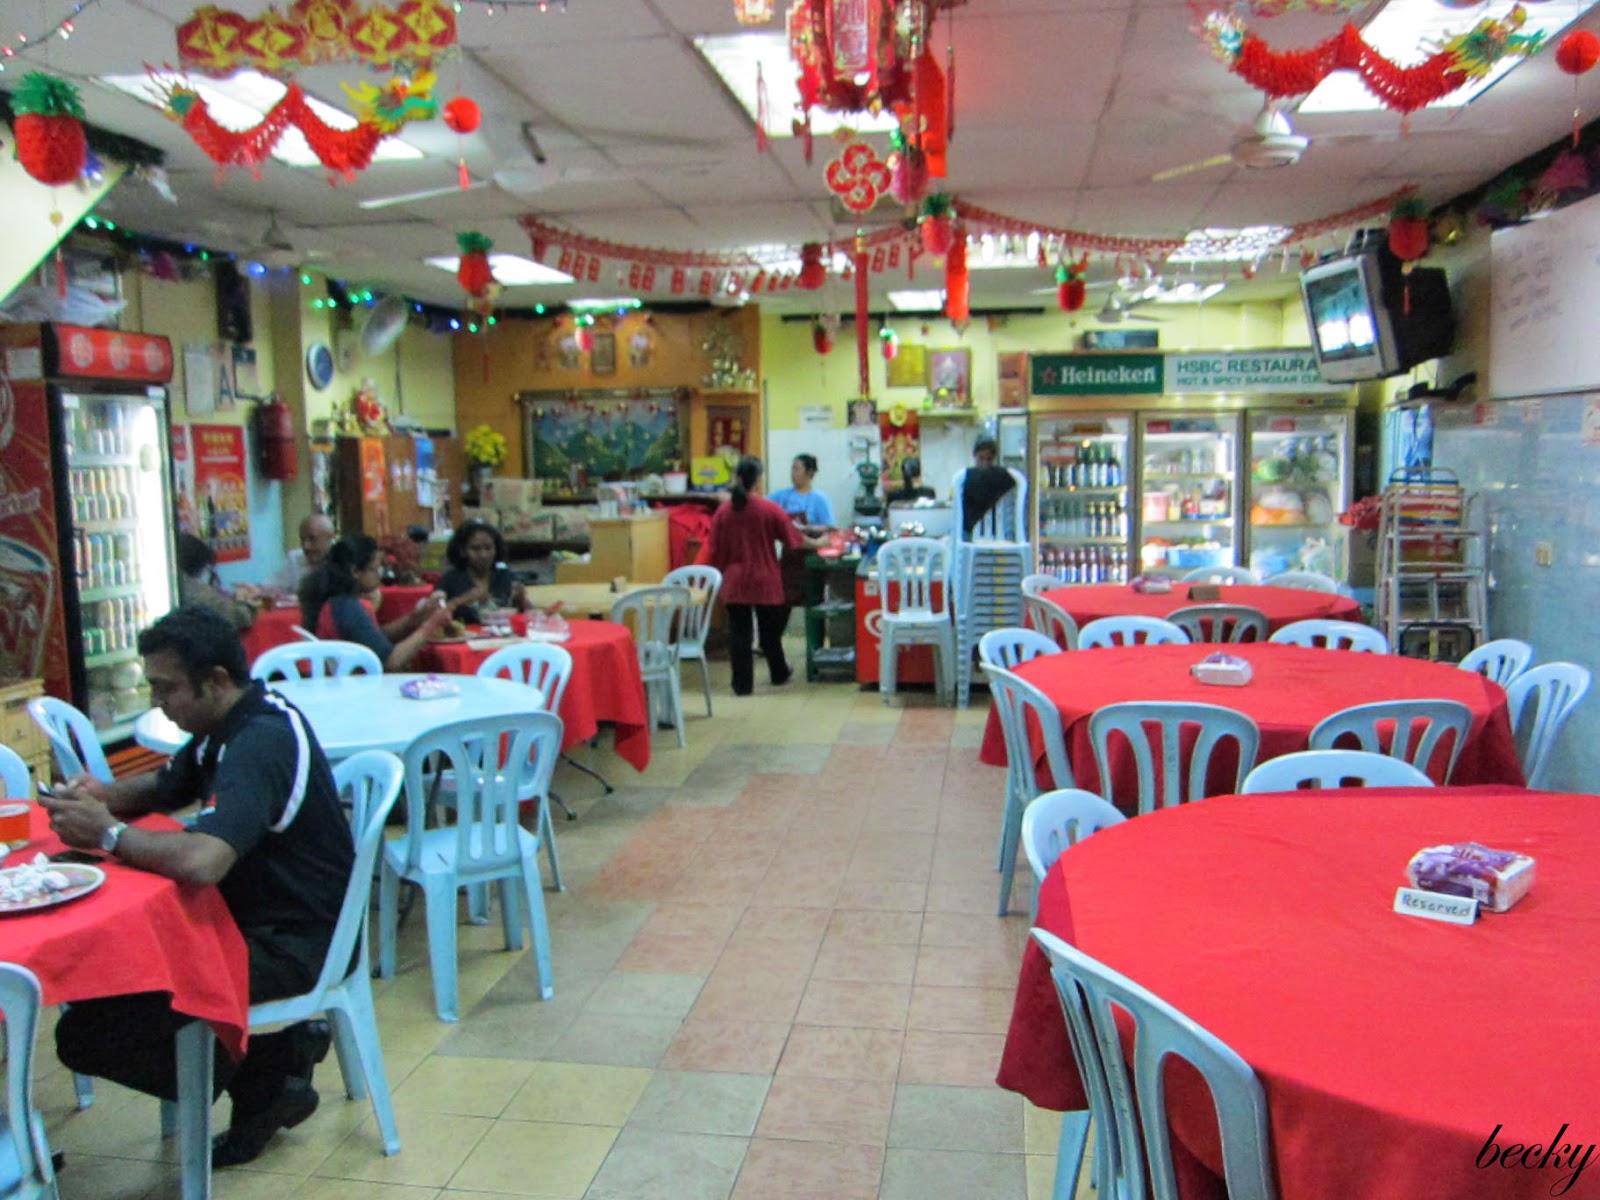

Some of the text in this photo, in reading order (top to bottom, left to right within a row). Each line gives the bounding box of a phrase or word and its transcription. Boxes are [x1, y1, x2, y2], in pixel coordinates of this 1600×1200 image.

[1177, 357, 1319, 374] HSBC RESTAURA
[1061, 365, 1157, 385] Heineken
[1177, 376, 1199, 386] HOT
[1402, 893, 1472, 917] Reserved
